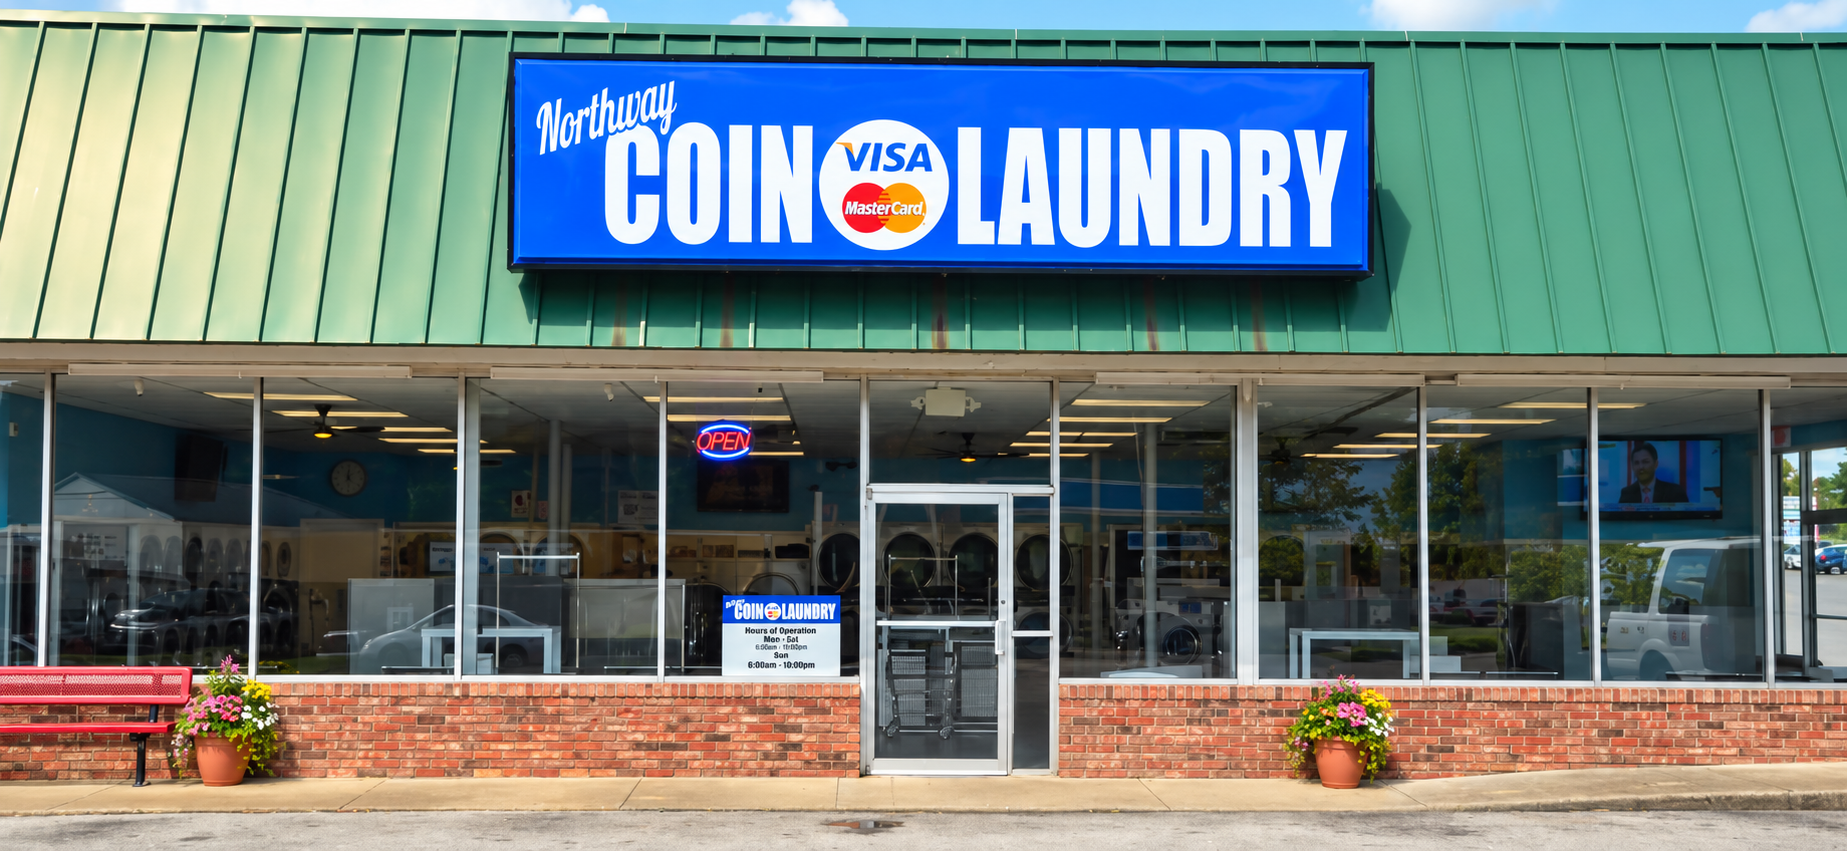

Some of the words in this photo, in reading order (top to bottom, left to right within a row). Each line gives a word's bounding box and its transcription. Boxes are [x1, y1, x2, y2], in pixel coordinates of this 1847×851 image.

[536, 80, 677, 155] Northway
[836, 142, 933, 172] VISA
[605, 122, 814, 245] COIN
[957, 126, 1348, 248] LAUNDRY
[844, 200, 925, 216] MasterCard
[696, 431, 751, 451] OPEN
[734, 602, 764, 620] COIN
[781, 602, 837, 620] LAUNDRY
[745, 626, 768, 634] Hours
[769, 626, 778, 634] of
[779, 626, 817, 635] Operation
[748, 661, 777, 669] 6:00am
